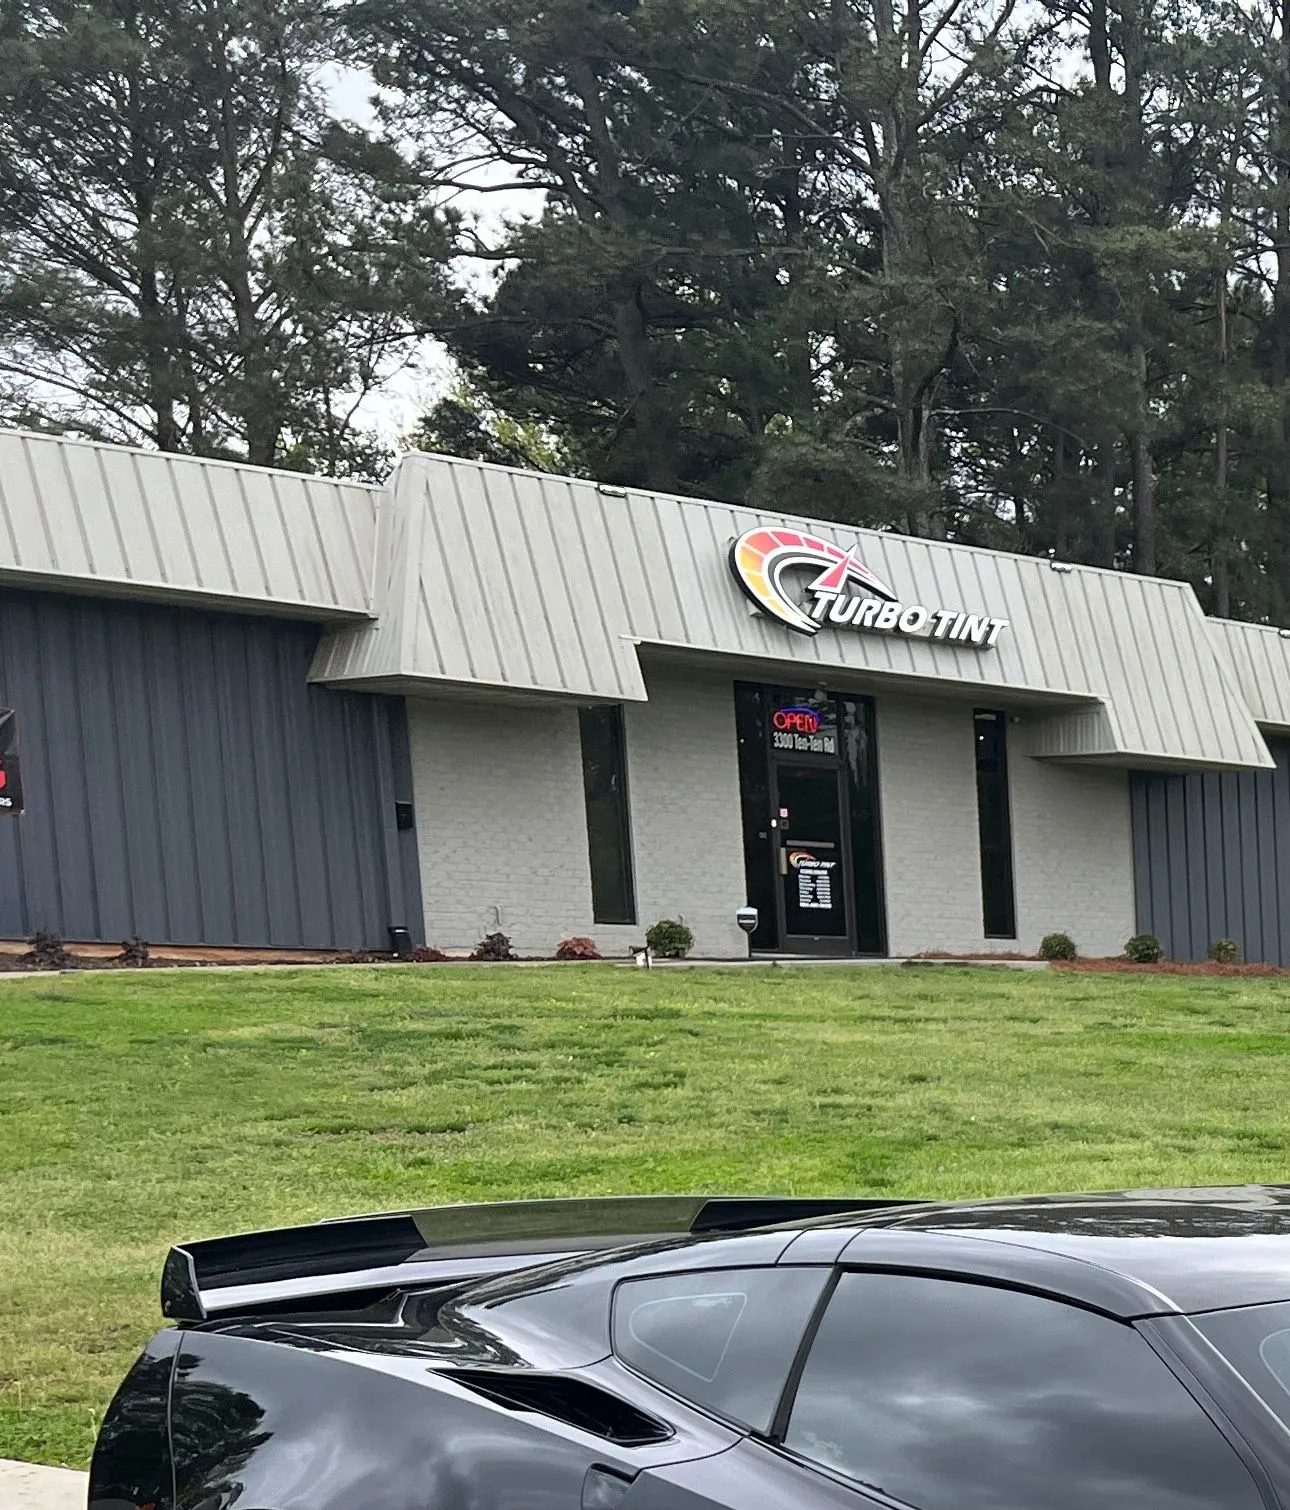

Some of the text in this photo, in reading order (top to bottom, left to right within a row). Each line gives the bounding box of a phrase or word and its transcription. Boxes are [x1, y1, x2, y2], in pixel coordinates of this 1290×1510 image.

[812, 592, 1010, 645] TURBO TINT
[773, 711, 817, 733] OPEN
[773, 731, 793, 749] 3300
